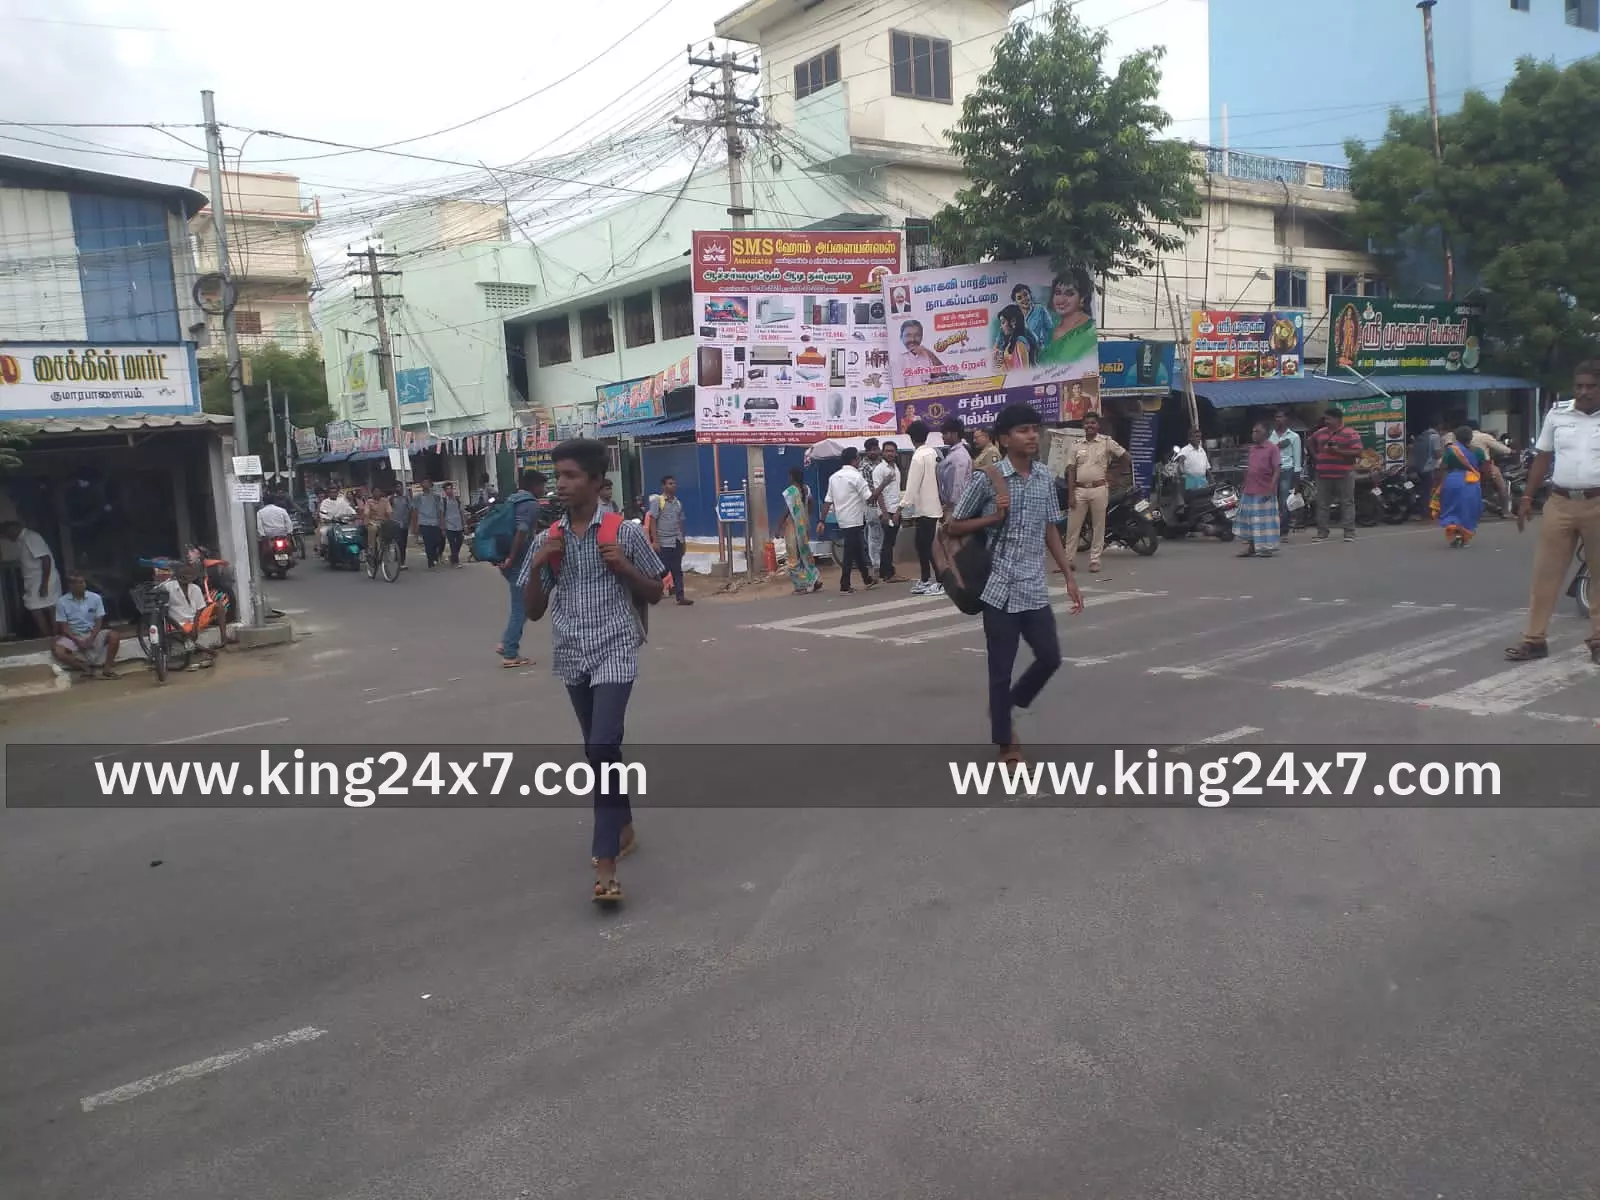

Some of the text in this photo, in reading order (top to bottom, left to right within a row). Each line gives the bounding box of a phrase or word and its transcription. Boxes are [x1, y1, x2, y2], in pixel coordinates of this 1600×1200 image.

[732, 238, 774, 256] SMS
[775, 240, 811, 257] ஹோம்
[783, 270, 805, 282] ஆடி
[914, 279, 958, 294] மகாகவி
[960, 272, 1008, 289] பாரதியார்
[925, 293, 999, 311] நாடகப்பட்டறை
[1383, 316, 1429, 350] முருகன்
[1429, 316, 1468, 346] பேக்கரி
[33, 349, 119, 382] சைக்கிள்
[122, 349, 169, 382] மார்ட்
[957, 392, 1007, 410] சத்யா
